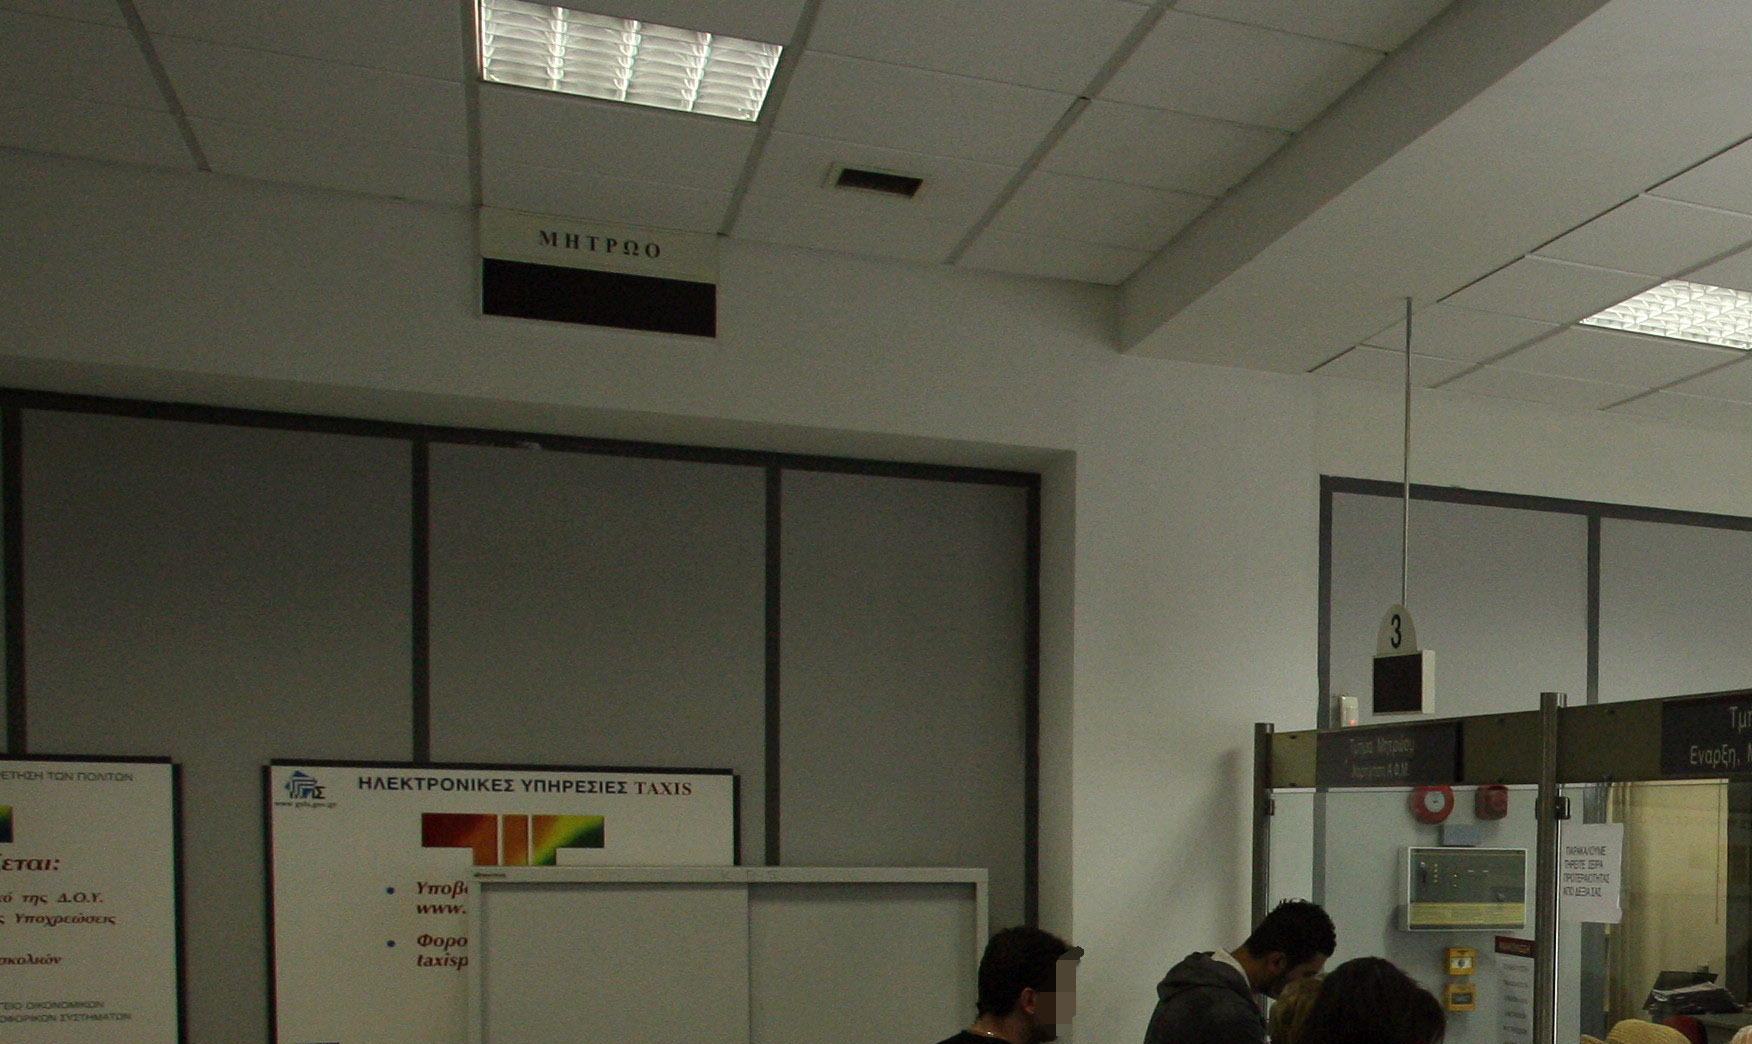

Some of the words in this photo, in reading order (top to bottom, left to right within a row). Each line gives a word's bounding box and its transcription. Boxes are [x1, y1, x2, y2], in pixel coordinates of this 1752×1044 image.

[539, 230, 661, 258] ΜΗΤΡΩΟ
[1390, 614, 1402, 649] 3
[0, 772, 43, 782] ΕΤΗΣΗ
[47, 771, 74, 782] ΤΩΝ
[358, 776, 515, 793] ΗΛΕΚΤΡΟΝΙΚΕΣ
[520, 777, 628, 795] ΥΠΗΡΕΣΙΕΣ
[634, 780, 693, 797] TAXIS
[22, 894, 47, 906] της
[57, 892, 103, 905] Δ.Ο.Υ.
[416, 903, 466, 915] www.
[16, 912, 116, 926] Υποχρεώσεις
[416, 933, 468, 951] Φορο
